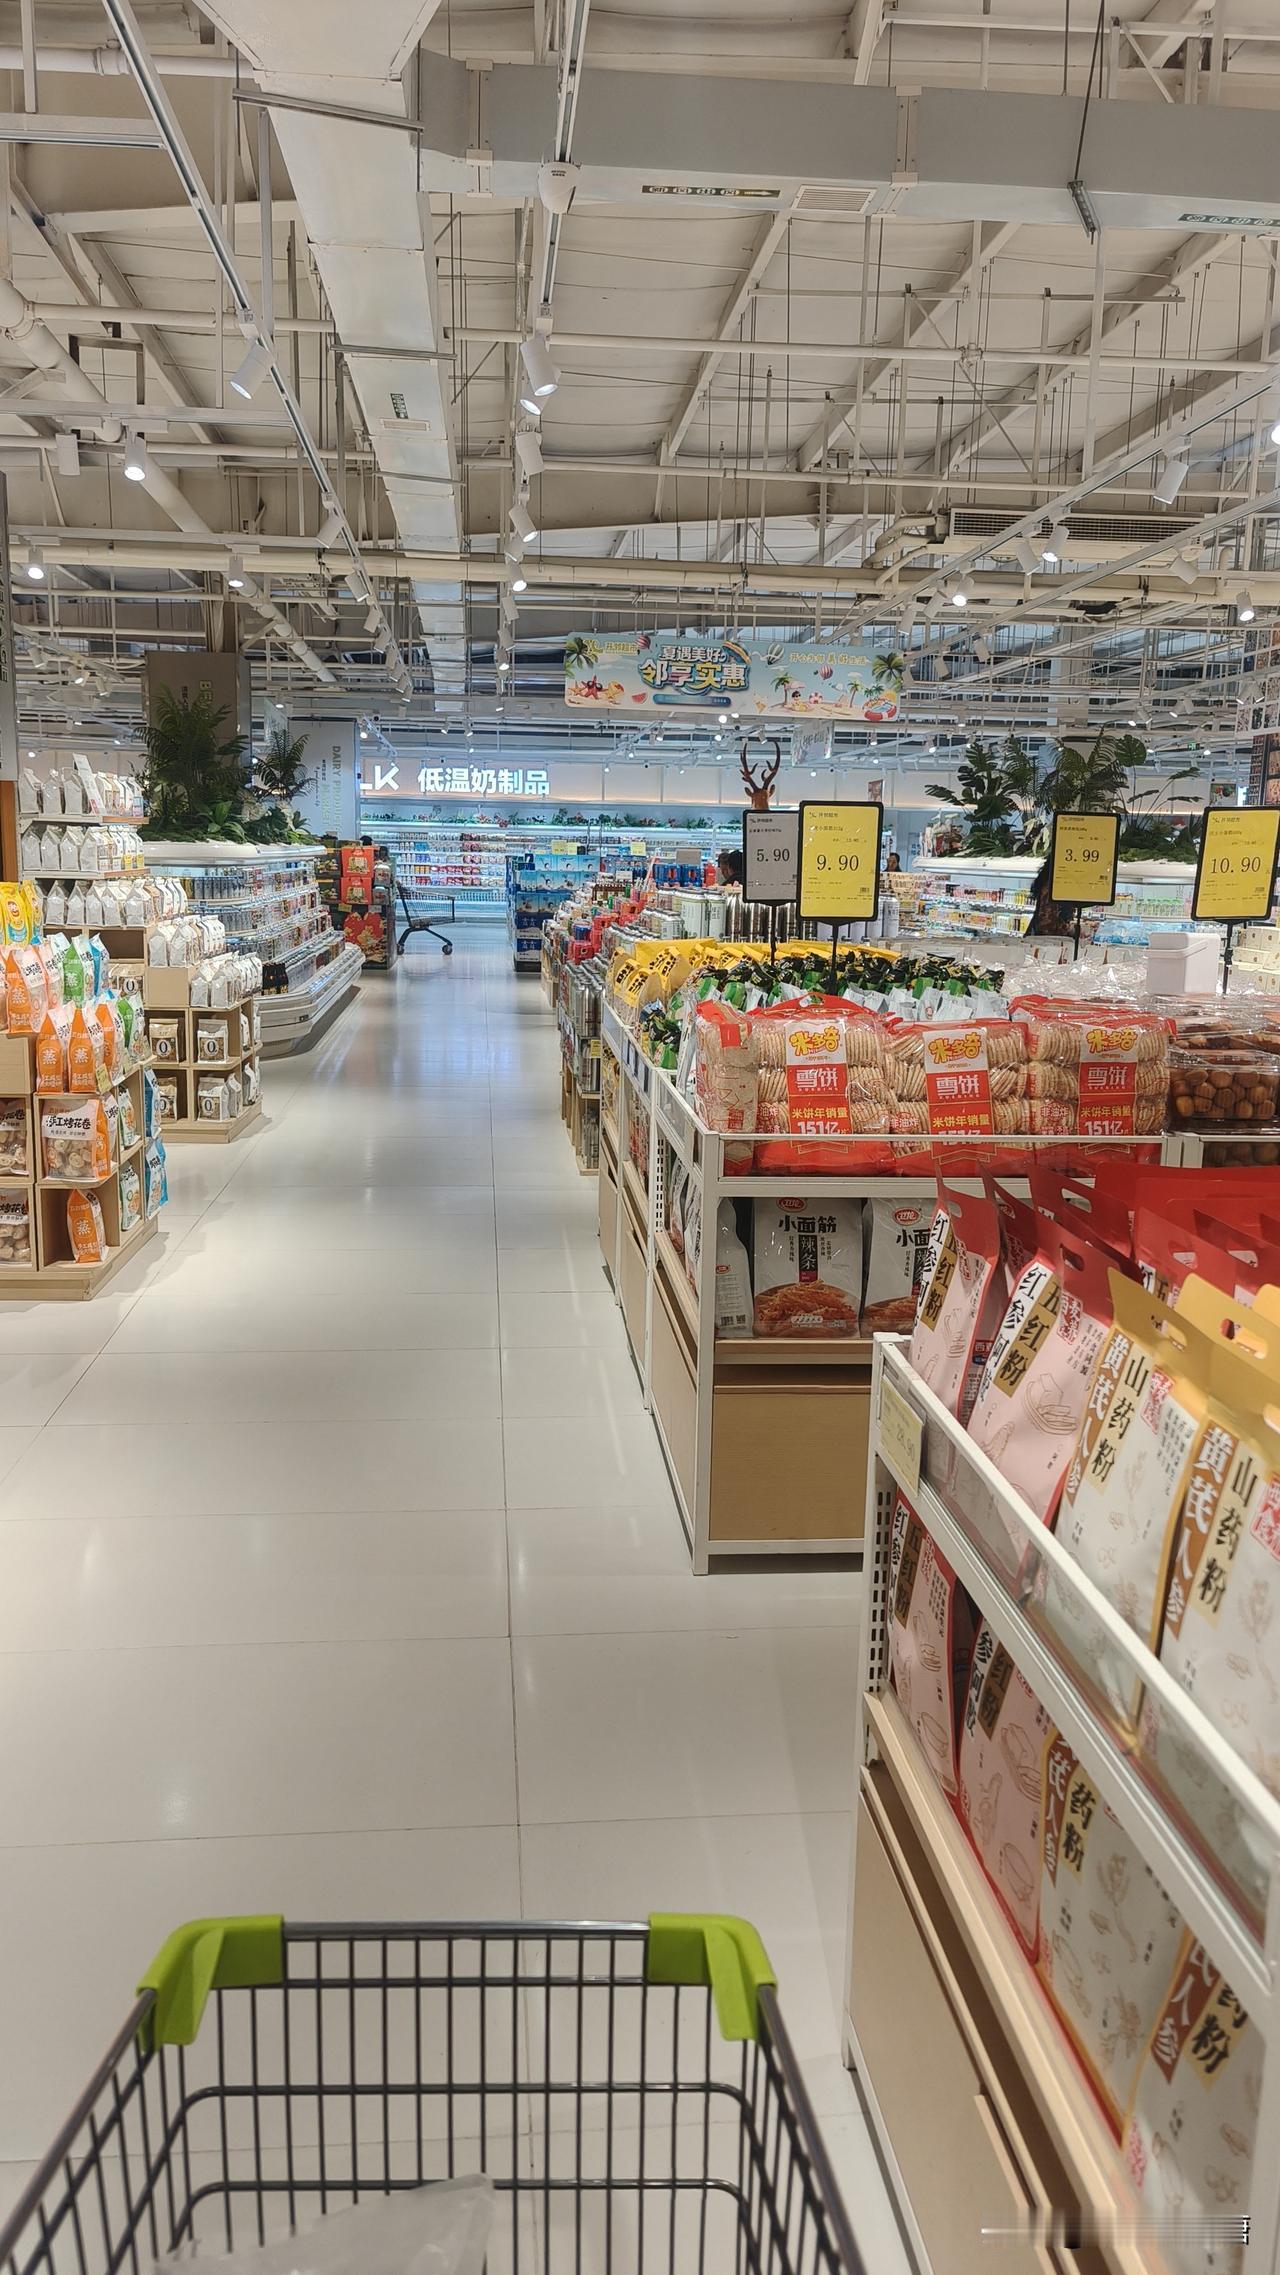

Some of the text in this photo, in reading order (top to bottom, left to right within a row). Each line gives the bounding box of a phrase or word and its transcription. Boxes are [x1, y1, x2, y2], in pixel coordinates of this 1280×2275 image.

[660, 646, 723, 663] 夏遇美好
[639, 659, 747, 689] 邻享实惠
[332, 746, 341, 777] DAIRY
[418, 767, 550, 796] 低温奶制品
[756, 848, 790, 862] 5.90
[816, 854, 859, 871] 9.90
[1065, 848, 1100, 863] 3.99
[1210, 856, 1262, 874] 10.90
[789, 1026, 840, 1056] 米多奇
[928, 1032, 982, 1064] 米多奇
[1086, 1027, 1138, 1054] 米多奇
[796, 1067, 838, 1088] 雪饼
[936, 1074, 980, 1096] 雪饼
[1088, 1066, 1128, 1086] 雪饼
[792, 1107, 848, 1118] 米饼年销量
[890, 1116, 919, 1128] 非油炸
[932, 1114, 990, 1127] 米饼年销量
[1040, 1107, 1069, 1118] 非油炸
[1081, 1105, 1132, 1117] 米饼年销量
[1084, 1120, 1124, 1135] 151亿
[778, 1215, 837, 1233] 小面筋
[799, 1235, 818, 1271] 辣条
[1000, 1281, 1062, 1387] 五红粉
[1064, 1333, 1131, 1494] 黄芪人参
[1090, 1355, 1149, 1483] 山药粉
[1165, 1426, 1234, 1623] 黄芪人参
[1200, 1457, 1258, 1614] 山药粉
[896, 1523, 922, 1618] 五红粉
[1062, 1781, 1097, 1873] 药粉
